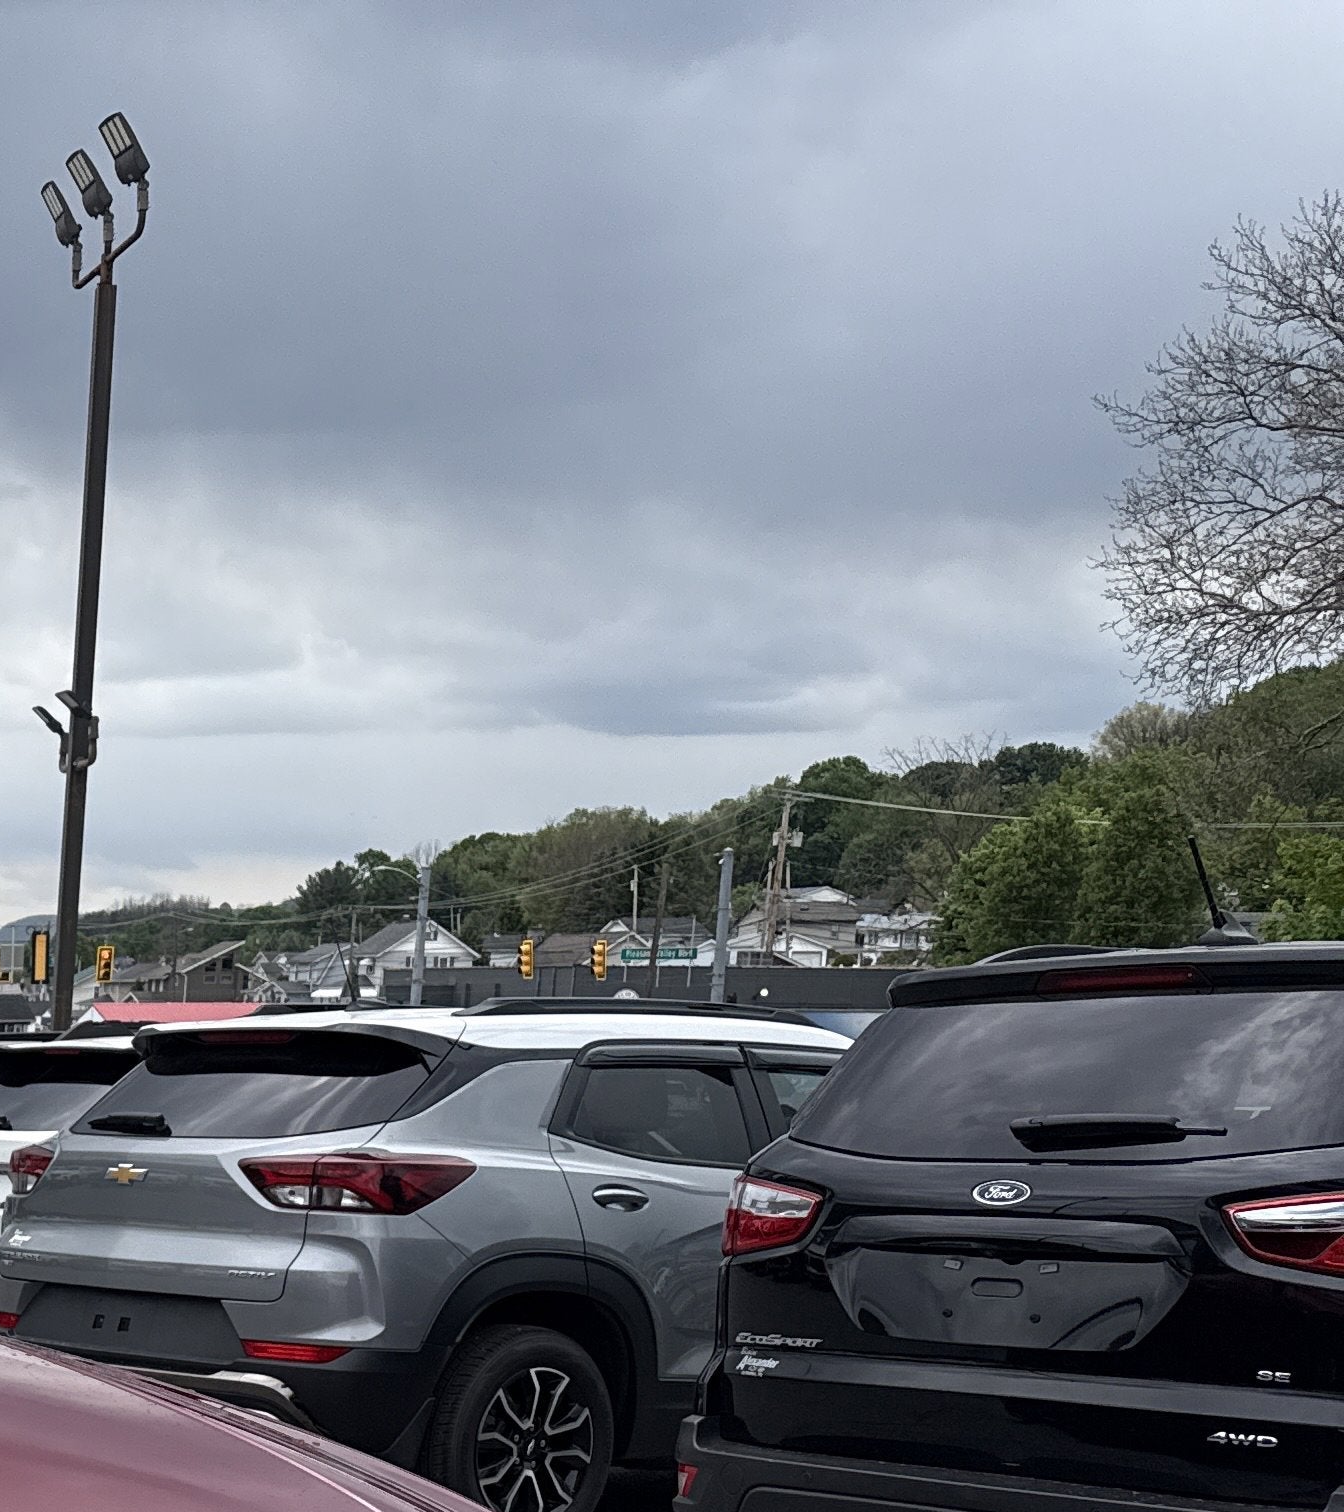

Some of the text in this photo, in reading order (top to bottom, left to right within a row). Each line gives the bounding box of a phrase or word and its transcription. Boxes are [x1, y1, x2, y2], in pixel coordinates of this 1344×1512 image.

[984, 1185, 1018, 1199] Ford
[1255, 1370, 1292, 1383] SE
[1206, 1431, 1279, 1448] 4WD
